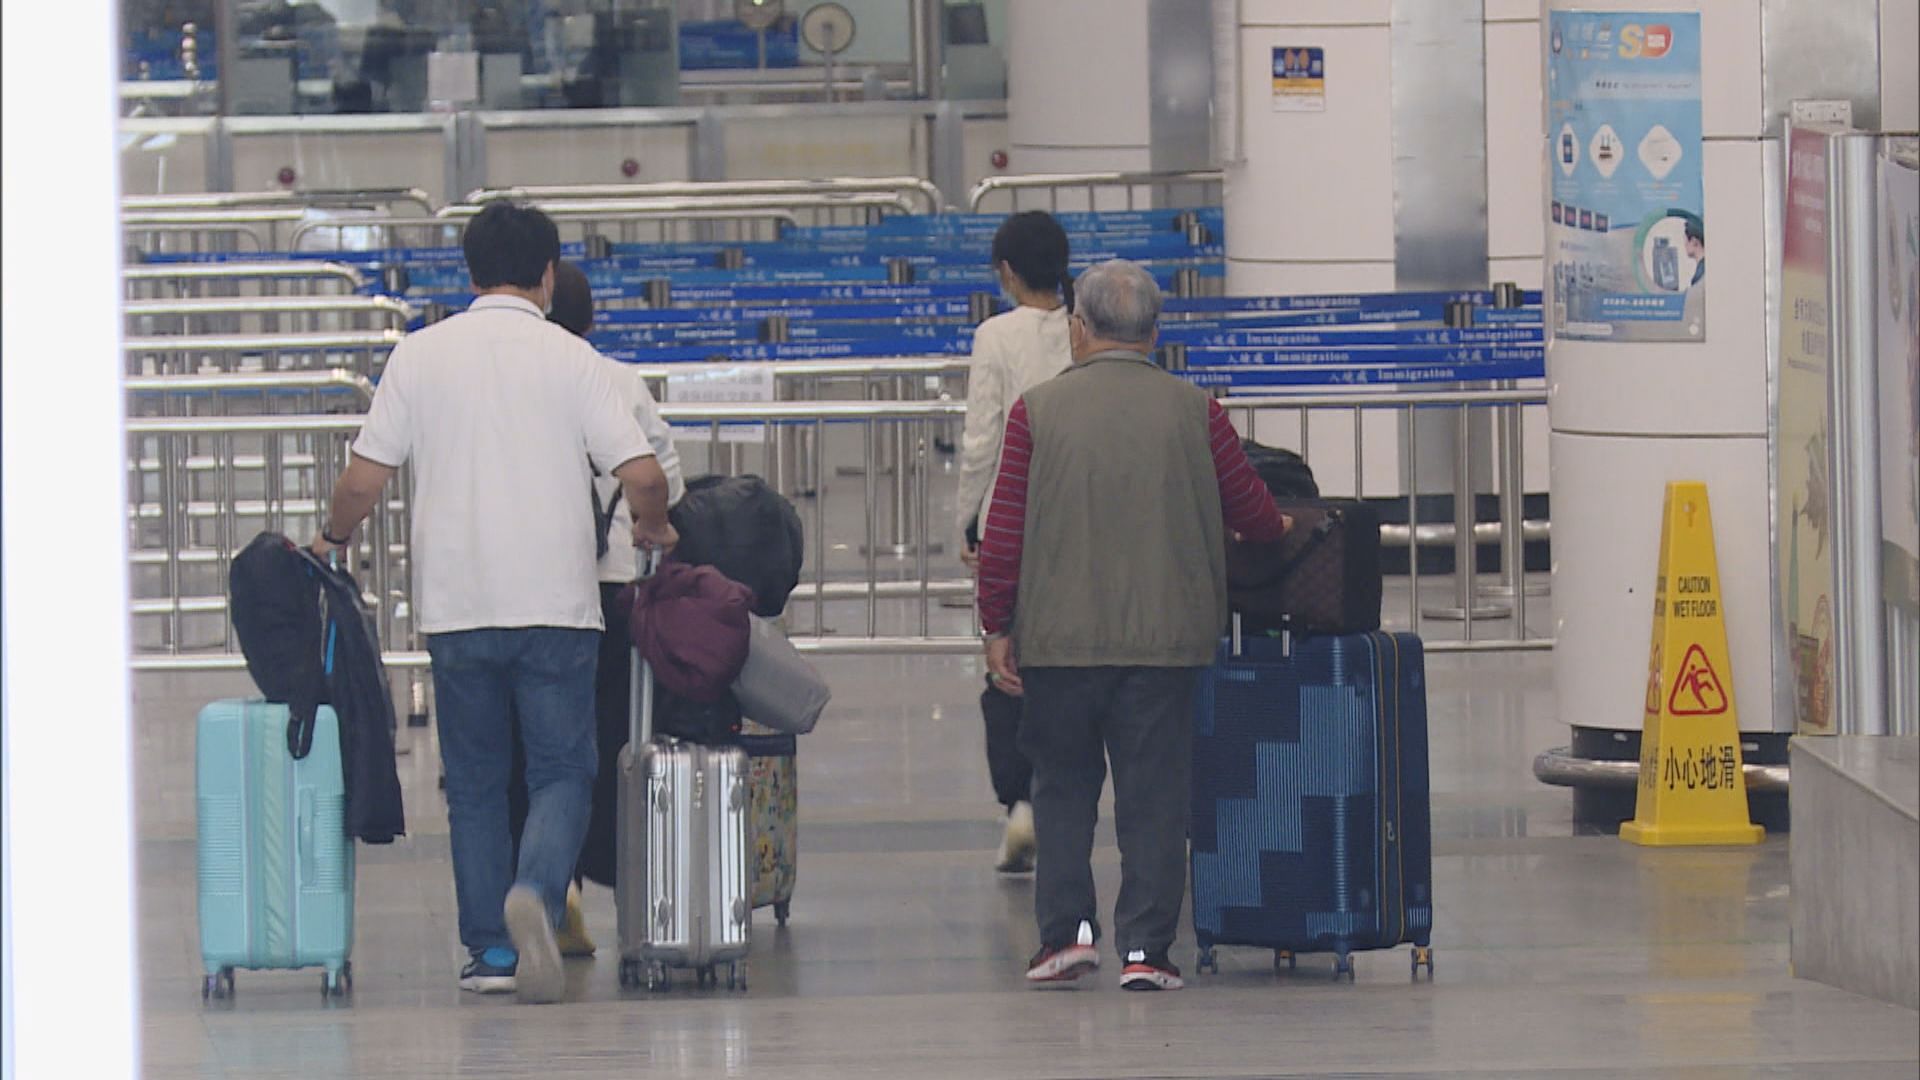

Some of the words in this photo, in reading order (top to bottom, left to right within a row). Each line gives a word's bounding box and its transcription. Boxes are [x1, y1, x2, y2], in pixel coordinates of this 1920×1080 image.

[1289, 295, 1361, 307] Immigration
[1246, 333, 1321, 345] Immigration
[1459, 330, 1534, 341] Immigration
[776, 343, 852, 356] Immigration
[1274, 351, 1350, 363] Immigration
[1378, 368, 1455, 381] Immigration
[1678, 575, 1711, 593] CAUTION
[1673, 600, 1690, 617] WET
[1691, 600, 1717, 617] FLOOR
[1664, 745, 1736, 790] 小心地滑
